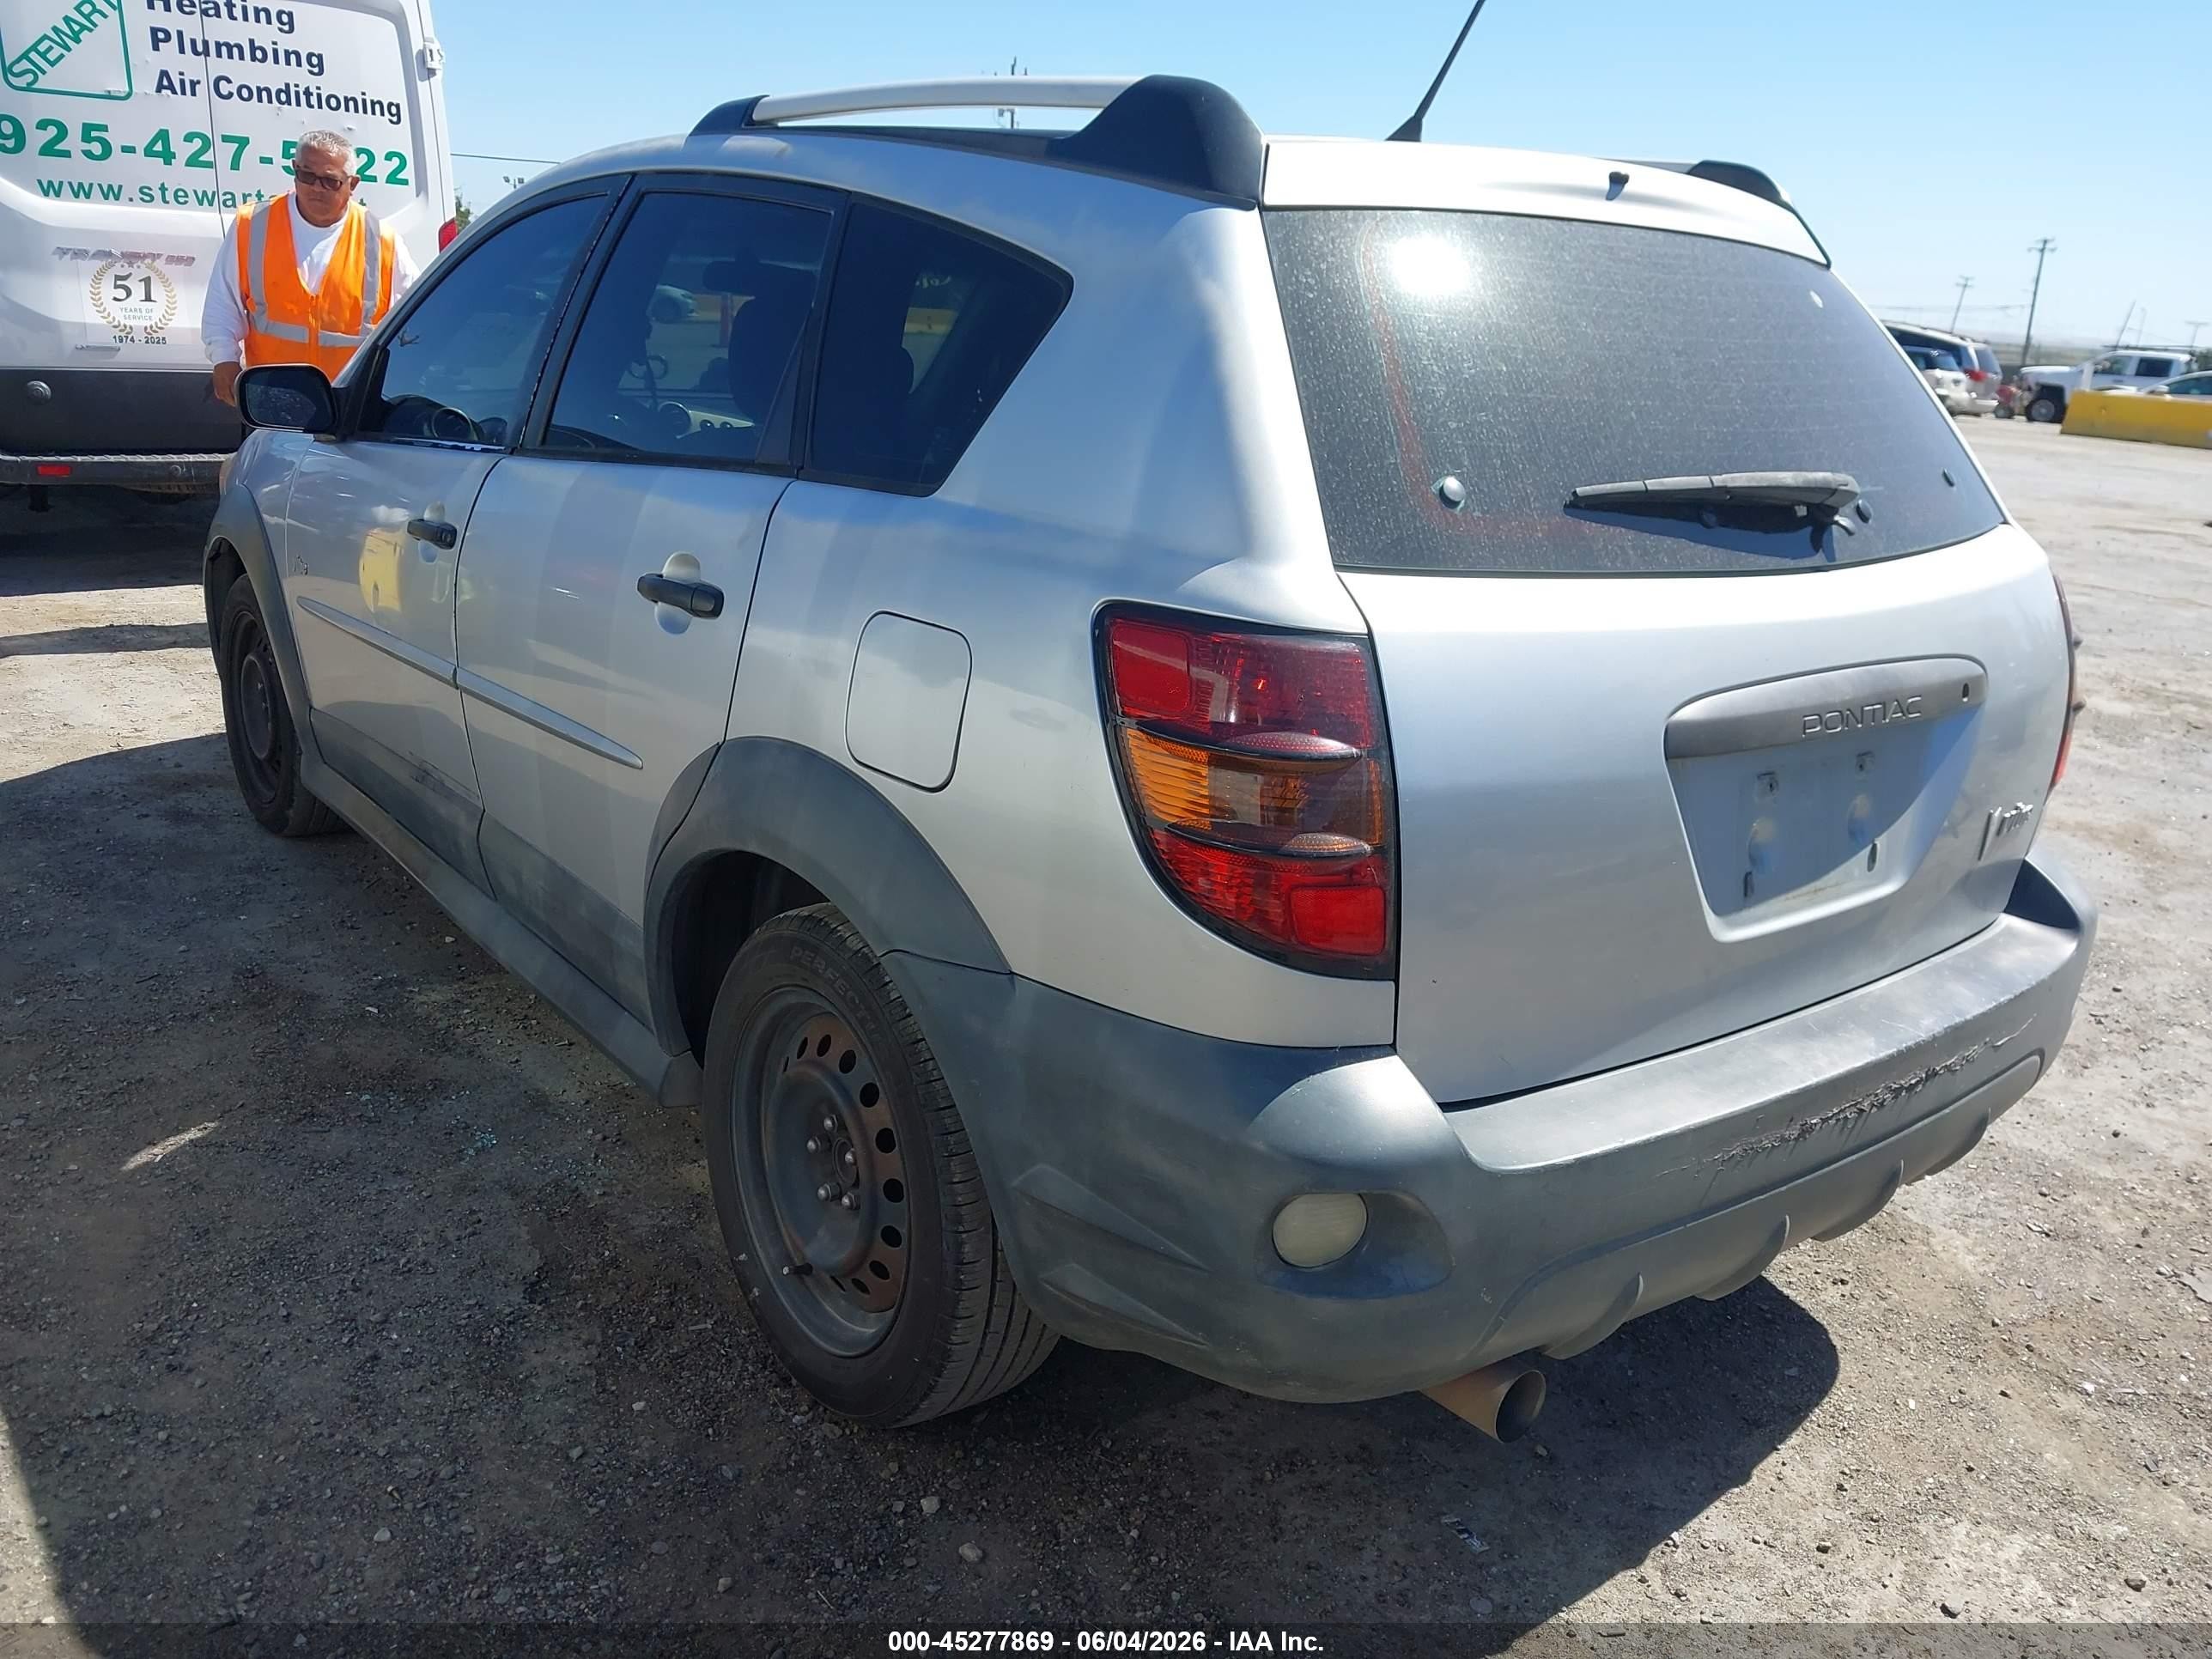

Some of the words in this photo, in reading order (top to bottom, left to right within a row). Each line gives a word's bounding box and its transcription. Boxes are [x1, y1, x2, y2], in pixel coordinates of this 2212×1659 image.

[149, 26, 324, 76] Plumbing
[155, 69, 201, 97] Air
[212, 75, 402, 125] Conditioning
[0, 113, 410, 186] 925-427-522
[112, 272, 157, 303] 51
[1802, 693, 1923, 738] PONTIAC
